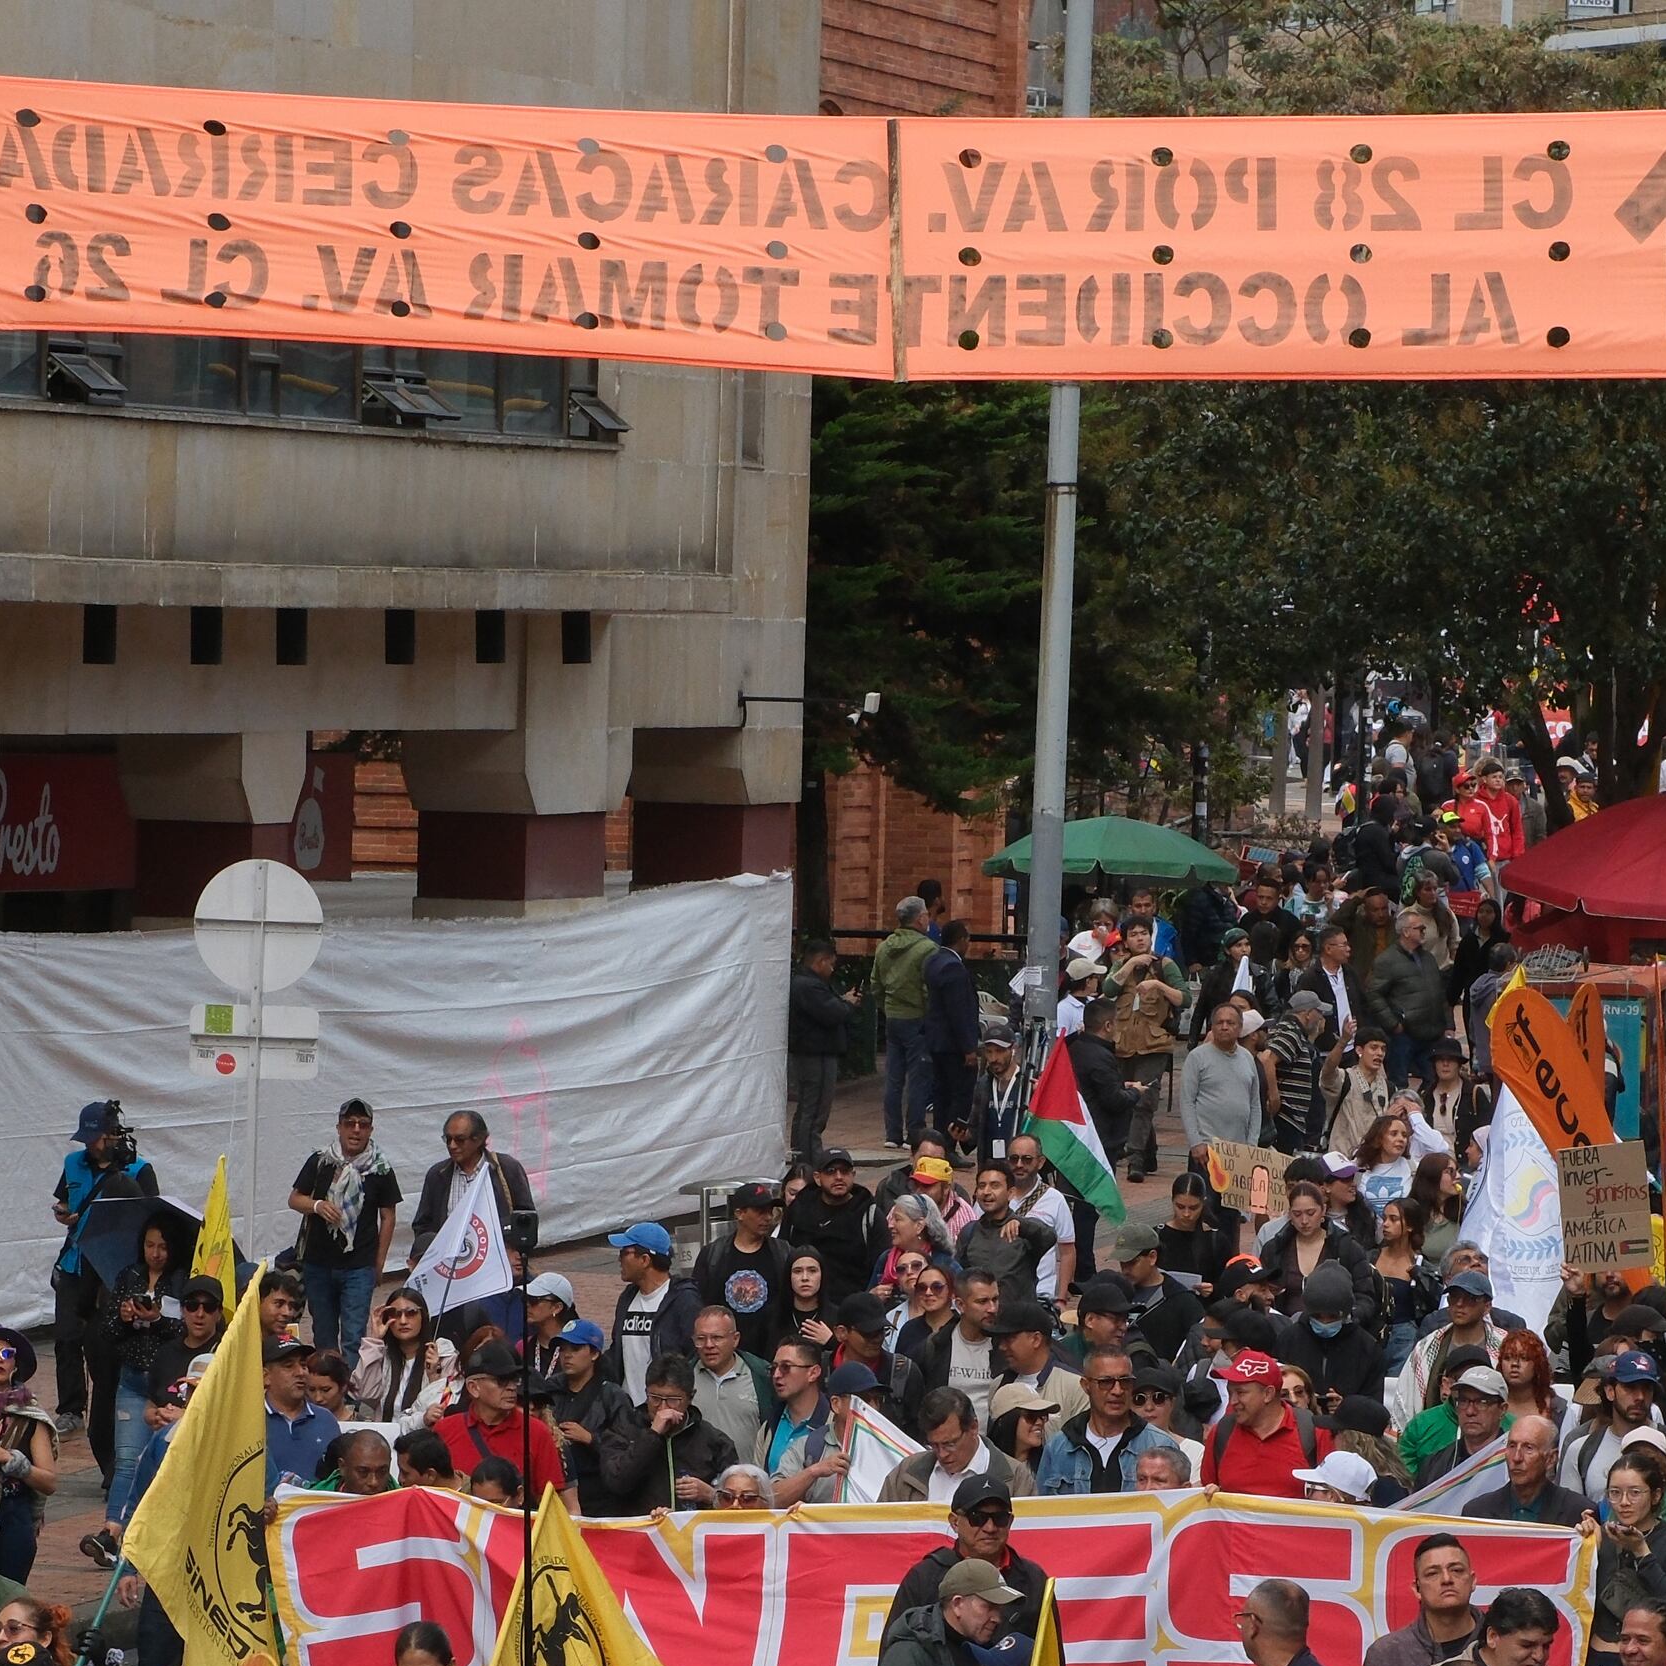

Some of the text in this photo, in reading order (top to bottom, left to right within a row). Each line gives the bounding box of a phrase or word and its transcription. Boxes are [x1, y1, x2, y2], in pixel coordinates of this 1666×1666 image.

[1560, 1147, 1600, 1168] FUERA
[1586, 1183, 1649, 1206] sionistas
[1591, 1206, 1605, 1222] de
[1564, 1218, 1627, 1239] AMÉRICA
[1564, 1241, 1617, 1264] LATINA
